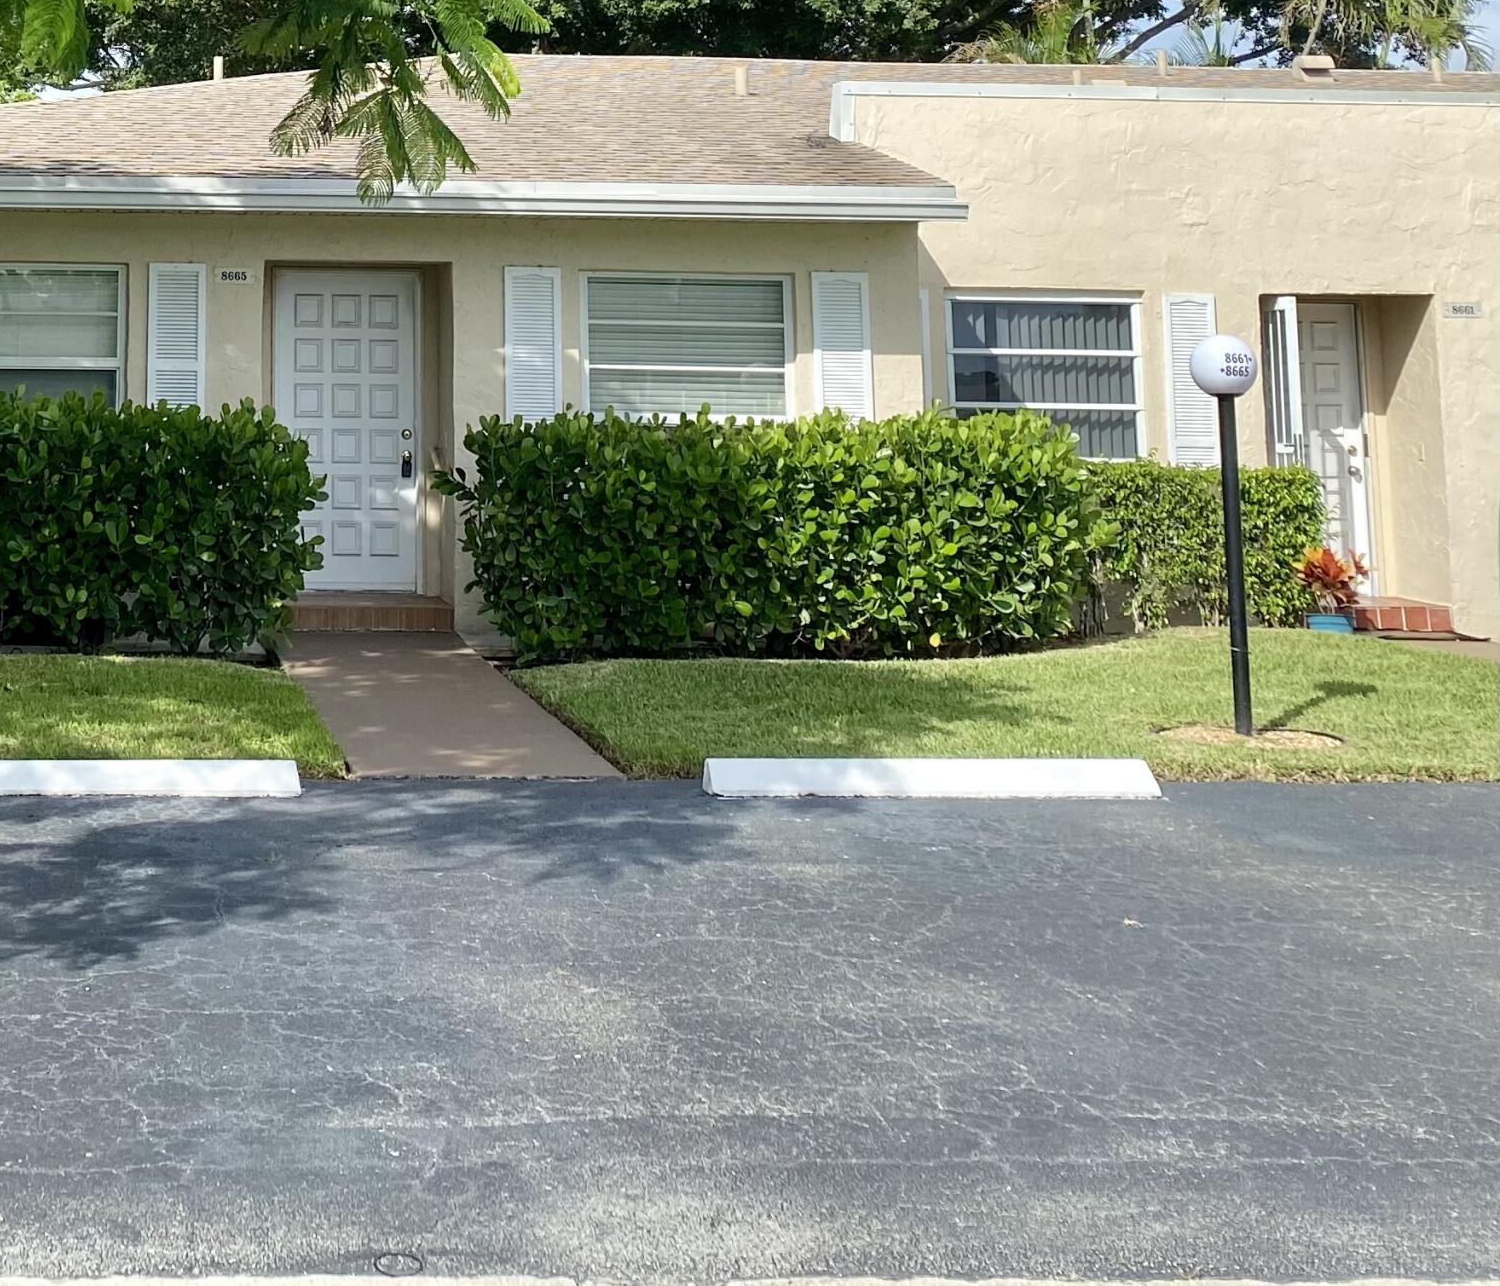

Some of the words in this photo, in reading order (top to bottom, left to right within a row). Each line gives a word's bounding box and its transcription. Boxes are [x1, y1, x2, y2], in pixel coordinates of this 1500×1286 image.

[221, 271, 247, 281] 8665
[1452, 305, 1476, 315] 8661
[1225, 353, 1249, 364] 8661
[1225, 365, 1249, 377] 8665
